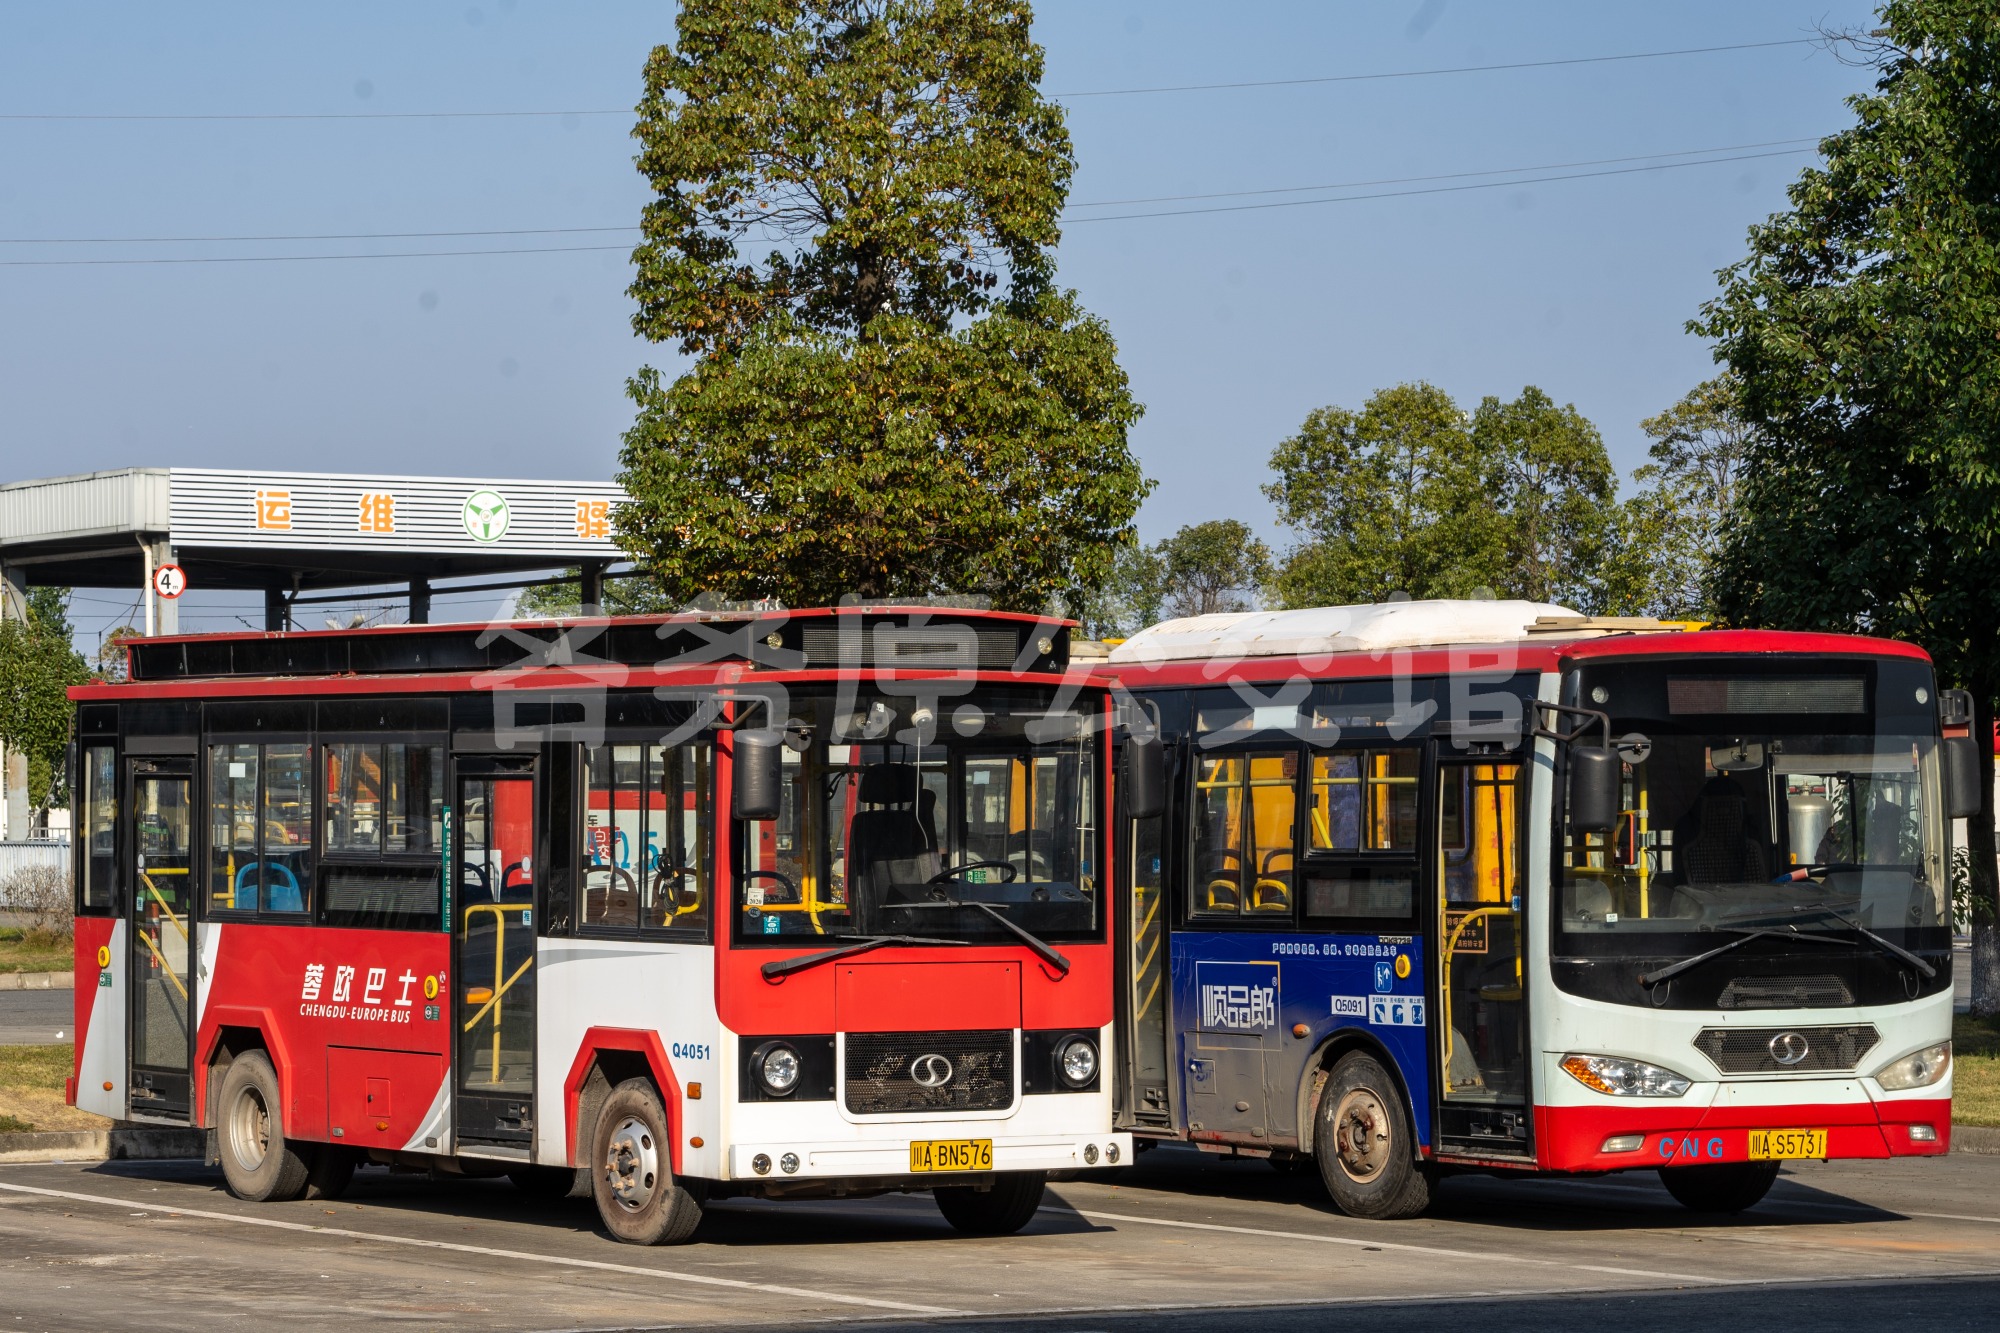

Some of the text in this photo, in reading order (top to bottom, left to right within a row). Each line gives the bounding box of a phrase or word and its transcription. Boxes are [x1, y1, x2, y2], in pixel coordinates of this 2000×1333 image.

[301, 963, 417, 1006] 蓉欧巴士
[299, 1003, 411, 1024] CHENGDU-EUROPE BUS
[1202, 984, 1275, 1030] 顺品郎
[1335, 998, 1363, 1013] Q5091
[672, 1042, 710, 1060] Q4051
[1659, 1137, 1724, 1158] CNG
